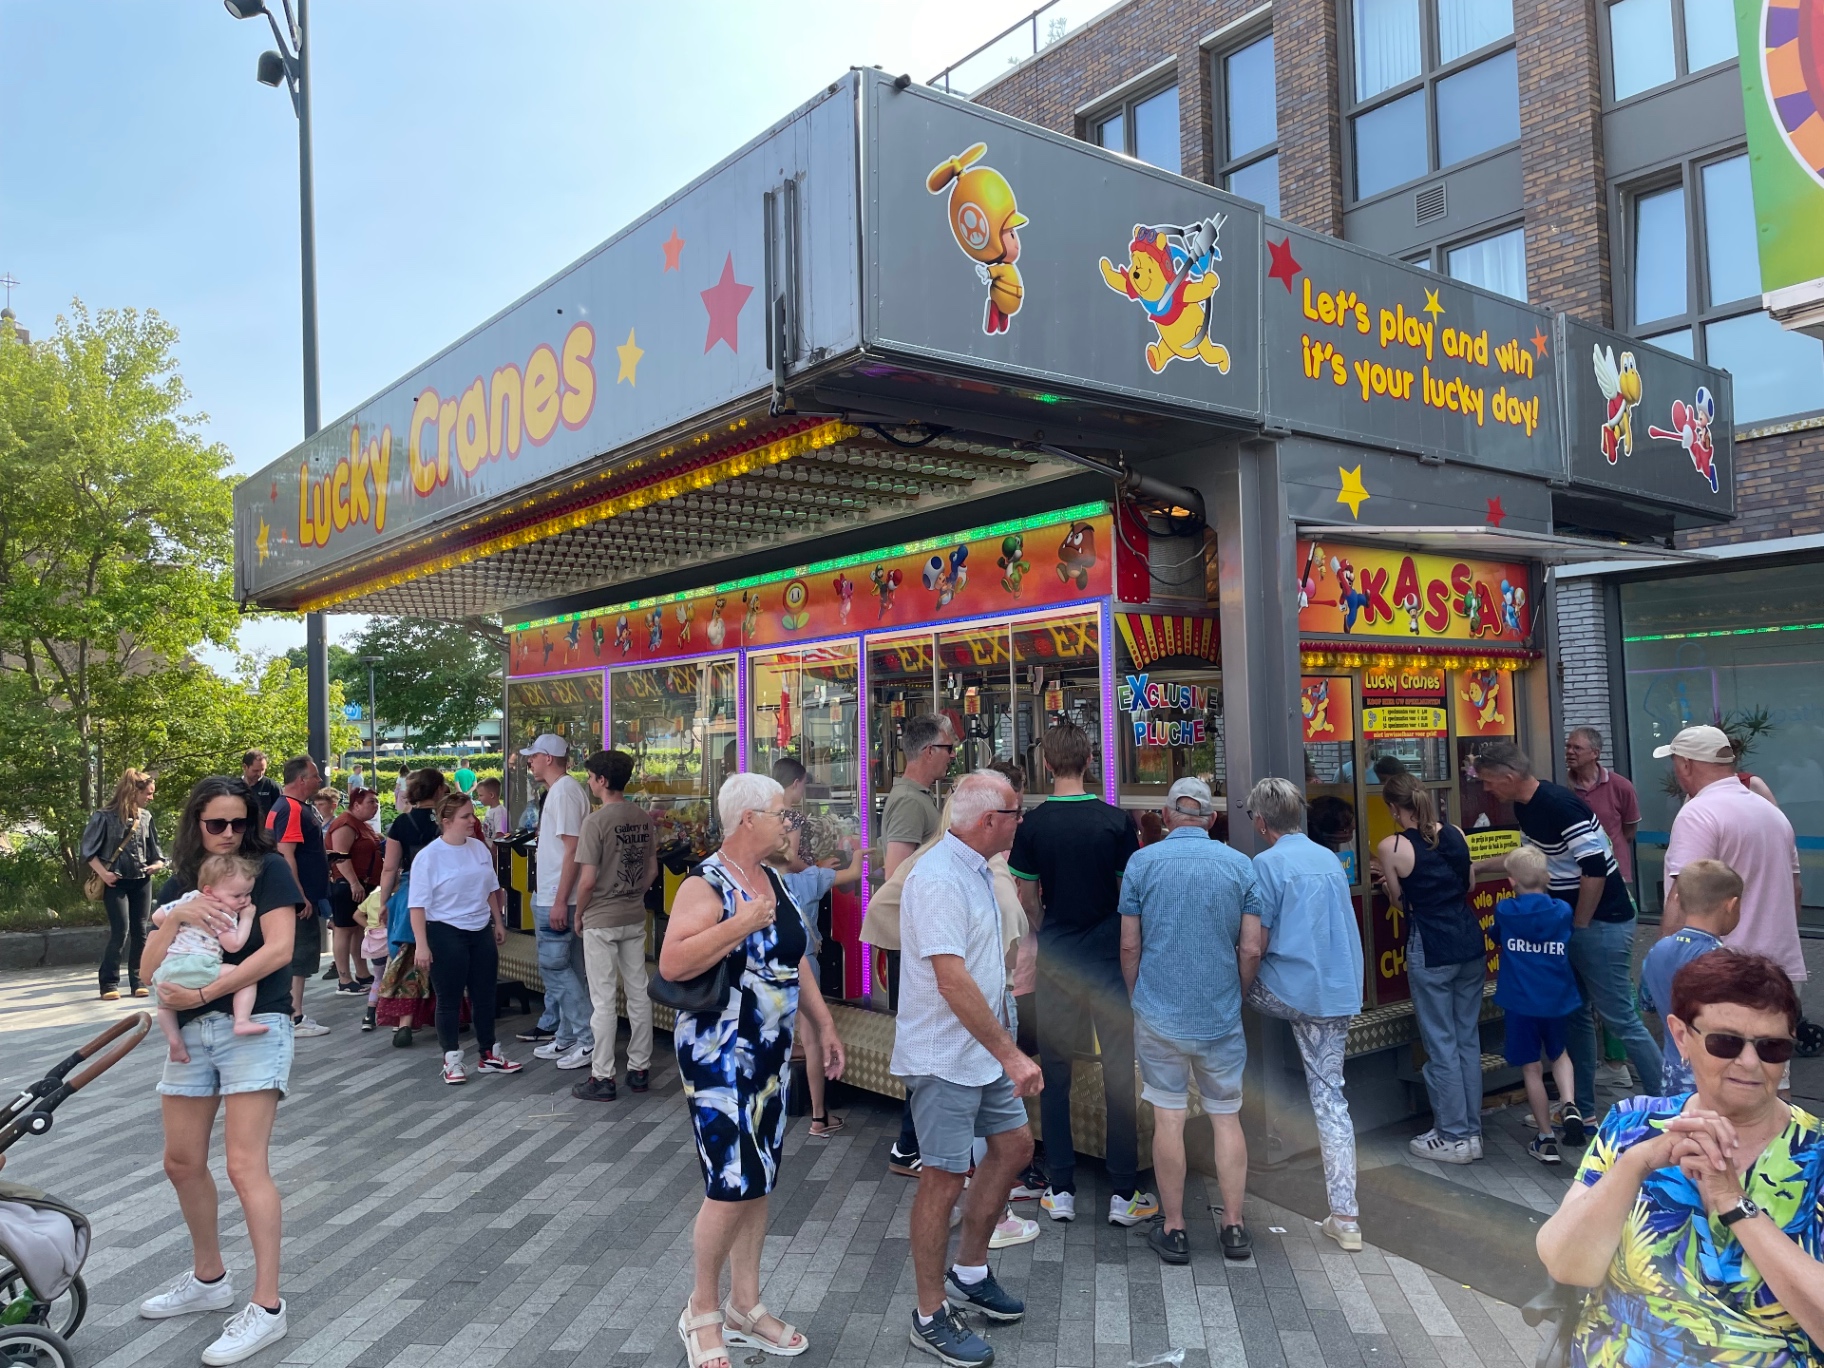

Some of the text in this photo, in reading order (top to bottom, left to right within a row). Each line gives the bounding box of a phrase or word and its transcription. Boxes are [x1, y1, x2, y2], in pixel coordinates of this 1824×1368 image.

[1301, 277, 1534, 379] Let's play and win
[1301, 333, 1540, 438] it's your lucky day!
[298, 320, 597, 549] Lucky Cranes
[1359, 555, 1503, 639] KASSA
[1117, 673, 1219, 713] EXCLUSIVE
[1365, 671, 1440, 693] Lucky Cranes
[1133, 719, 1206, 746] PLUCHE
[615, 823, 642, 834] Gallery
[616, 833, 650, 846] Nature
[1473, 890, 1493, 910] wie
[1380, 946, 1408, 979] CH
